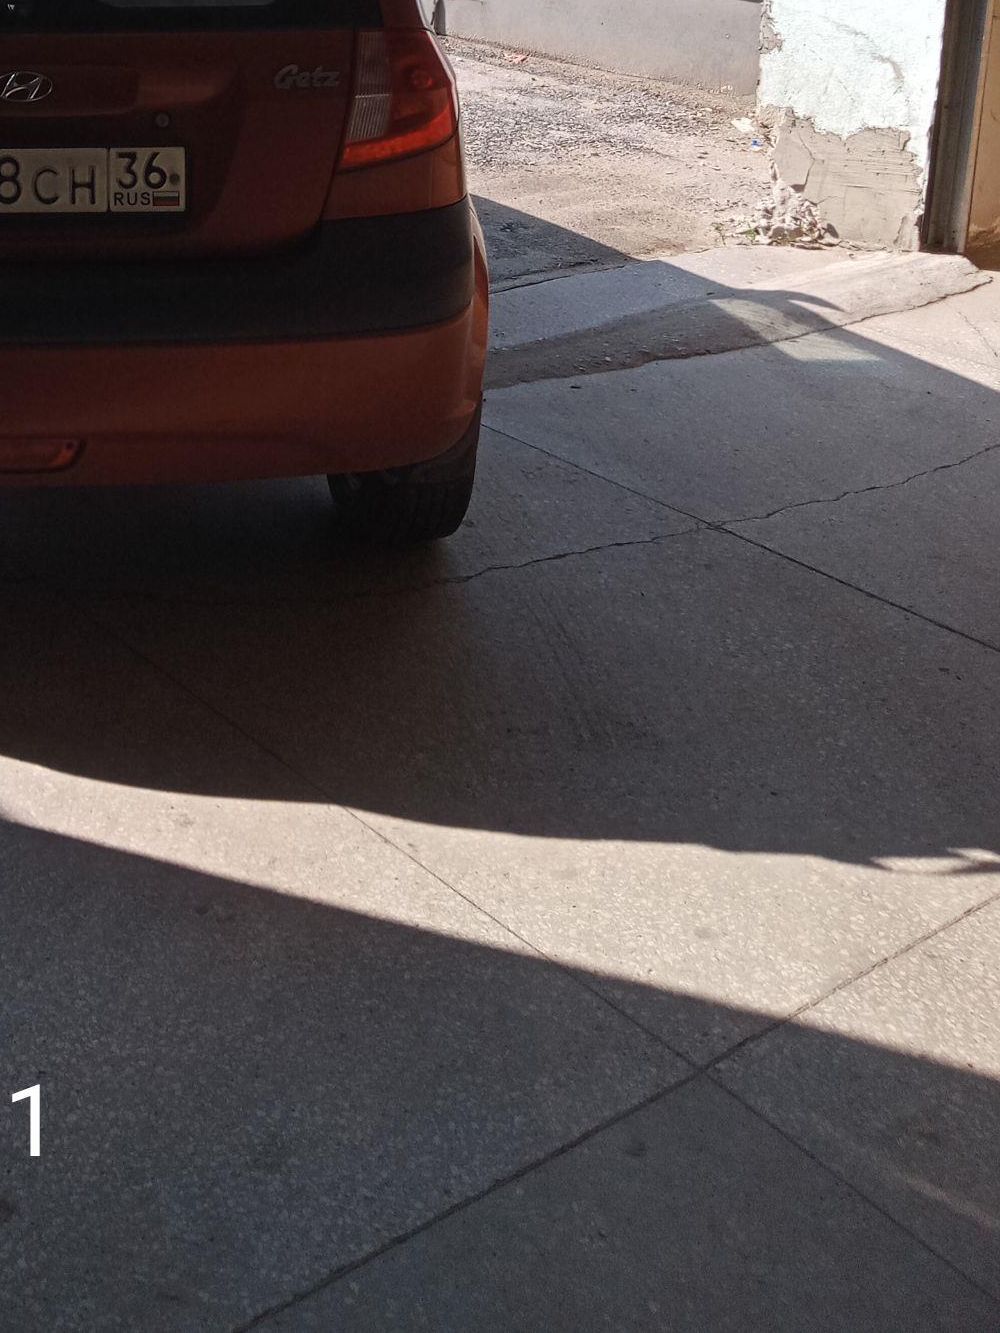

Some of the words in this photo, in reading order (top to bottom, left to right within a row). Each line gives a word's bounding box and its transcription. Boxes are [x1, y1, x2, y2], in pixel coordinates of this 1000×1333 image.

[273, 63, 341, 90] Getz
[115, 151, 168, 189] 36
[113, 191, 151, 206] RUS
